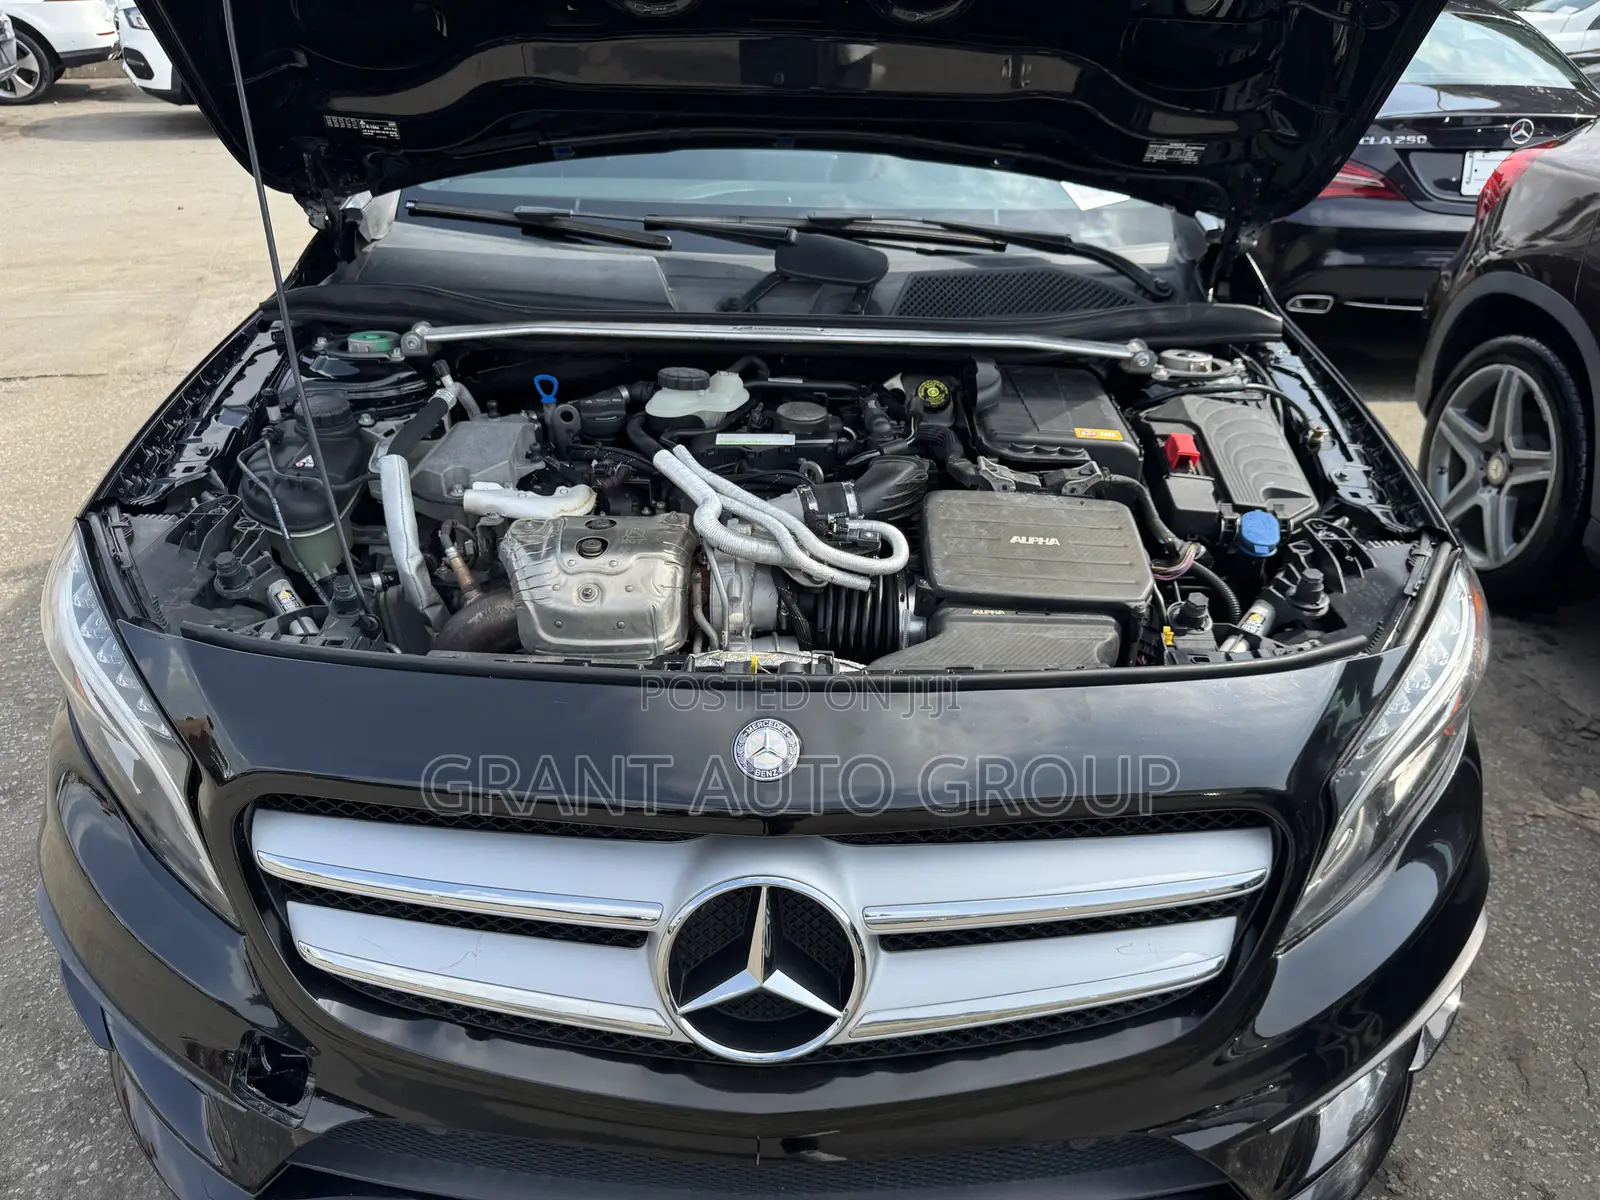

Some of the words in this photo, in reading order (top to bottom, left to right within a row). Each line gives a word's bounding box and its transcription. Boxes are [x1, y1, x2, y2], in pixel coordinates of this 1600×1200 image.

[1358, 135, 1393, 145] CLA
[1394, 135, 1428, 145] 250
[1009, 535, 1061, 546] ALPHA
[746, 720, 789, 735] MERCEDES
[754, 769, 778, 778] BENZ
